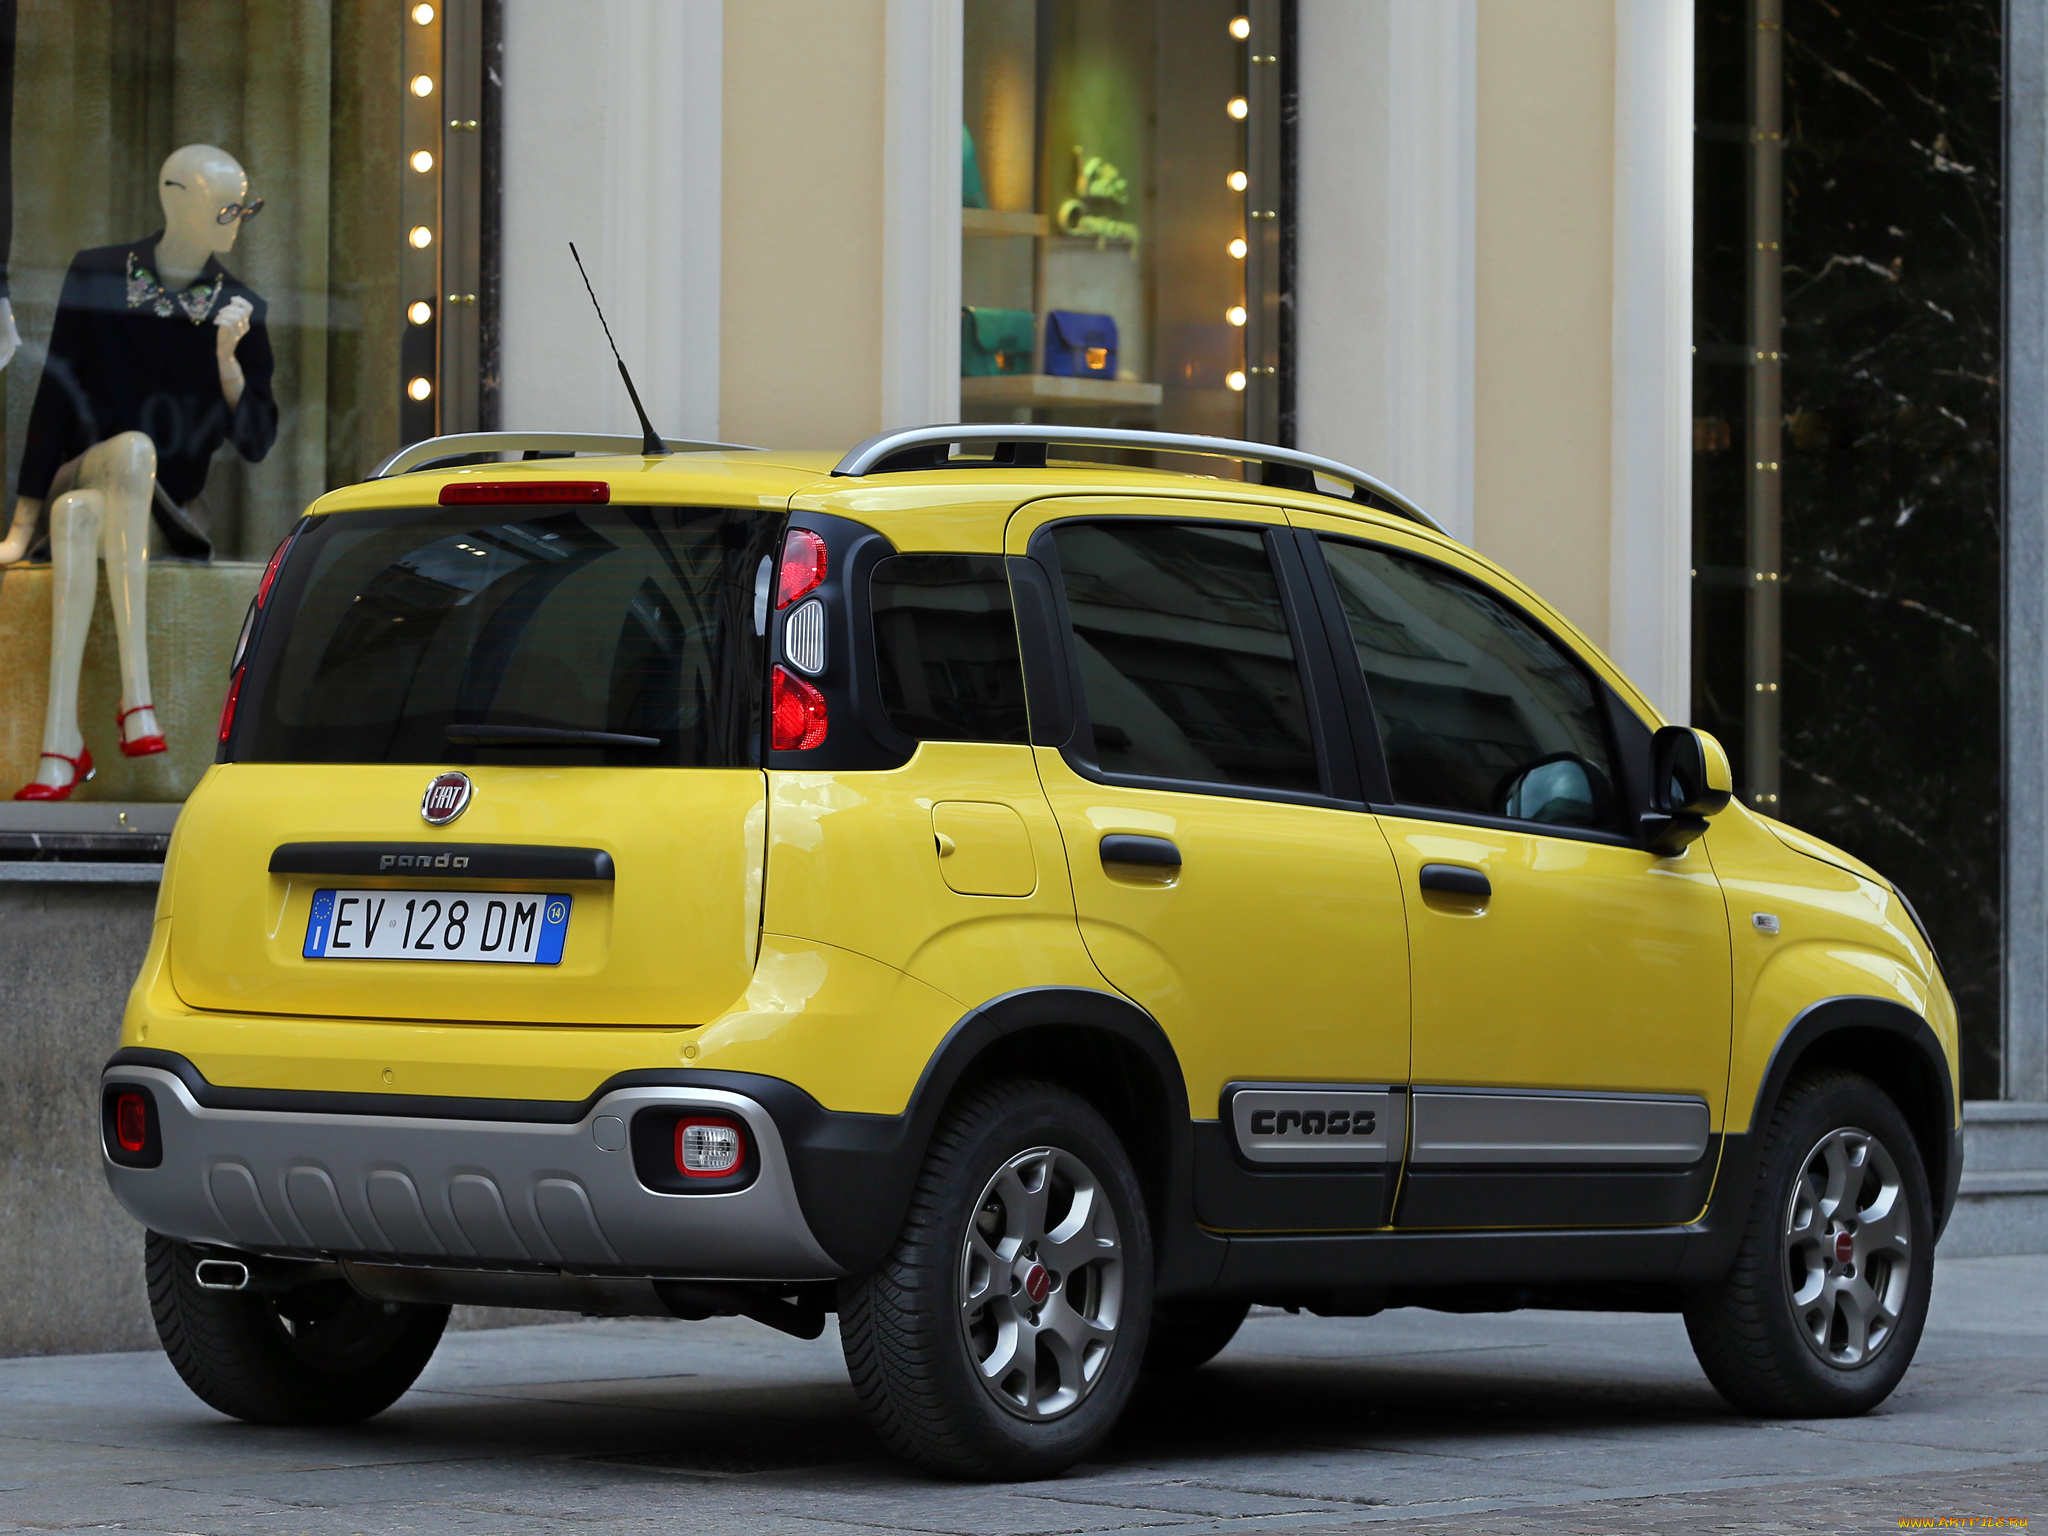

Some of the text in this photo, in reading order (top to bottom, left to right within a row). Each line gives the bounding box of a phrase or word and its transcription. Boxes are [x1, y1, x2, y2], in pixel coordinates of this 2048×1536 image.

[429, 785, 463, 809] FIAT
[379, 852, 470, 871] panda
[551, 907, 561, 919] 14
[332, 898, 386, 949] EV
[402, 898, 470, 951] 128
[480, 900, 538, 953] DM
